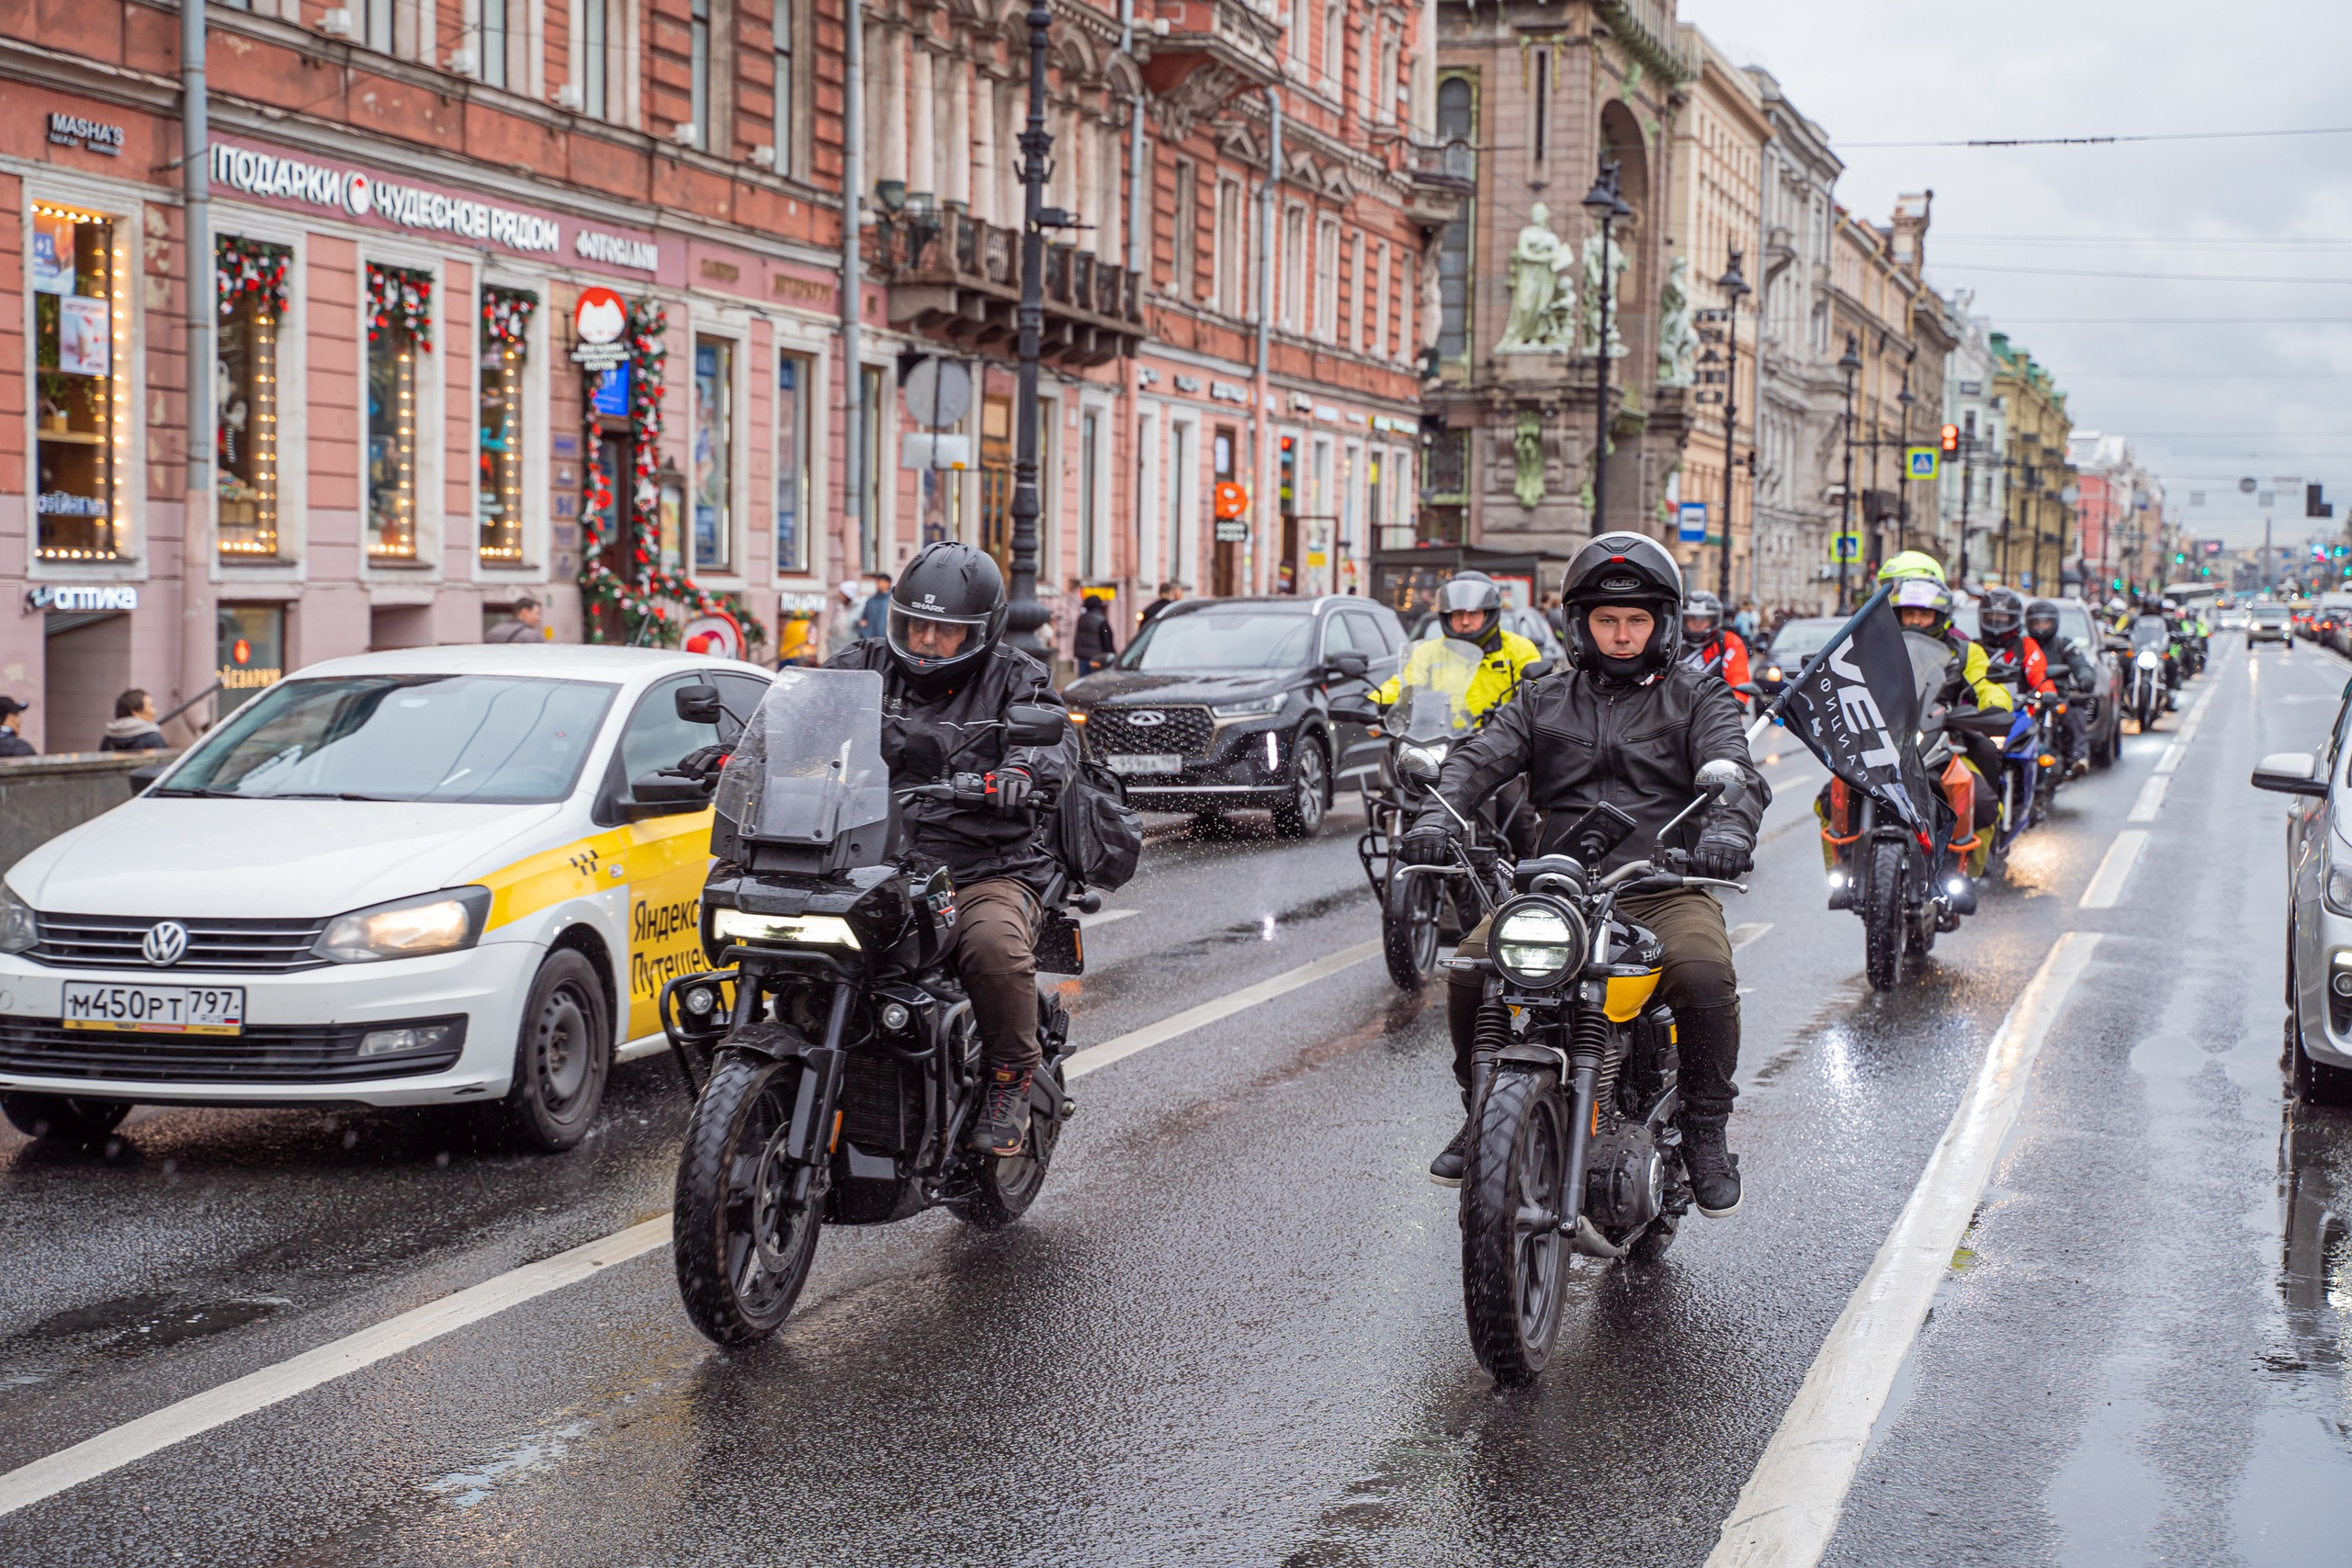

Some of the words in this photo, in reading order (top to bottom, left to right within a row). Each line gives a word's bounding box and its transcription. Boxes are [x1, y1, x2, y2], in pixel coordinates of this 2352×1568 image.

[52, 112, 124, 146] MASHA'S
[210, 142, 340, 208] ПОДАРКИ
[375, 181, 487, 241] ЧУДЕСНОЕ
[491, 208, 559, 253] РЯДОМ
[1605, 579, 1635, 587] HJC
[911, 601, 946, 614] SHARK
[634, 899, 699, 943] Яндекс
[72, 988, 183, 1021] М450РТ
[190, 990, 233, 1014] 797
[199, 1013, 223, 1023] RUS
